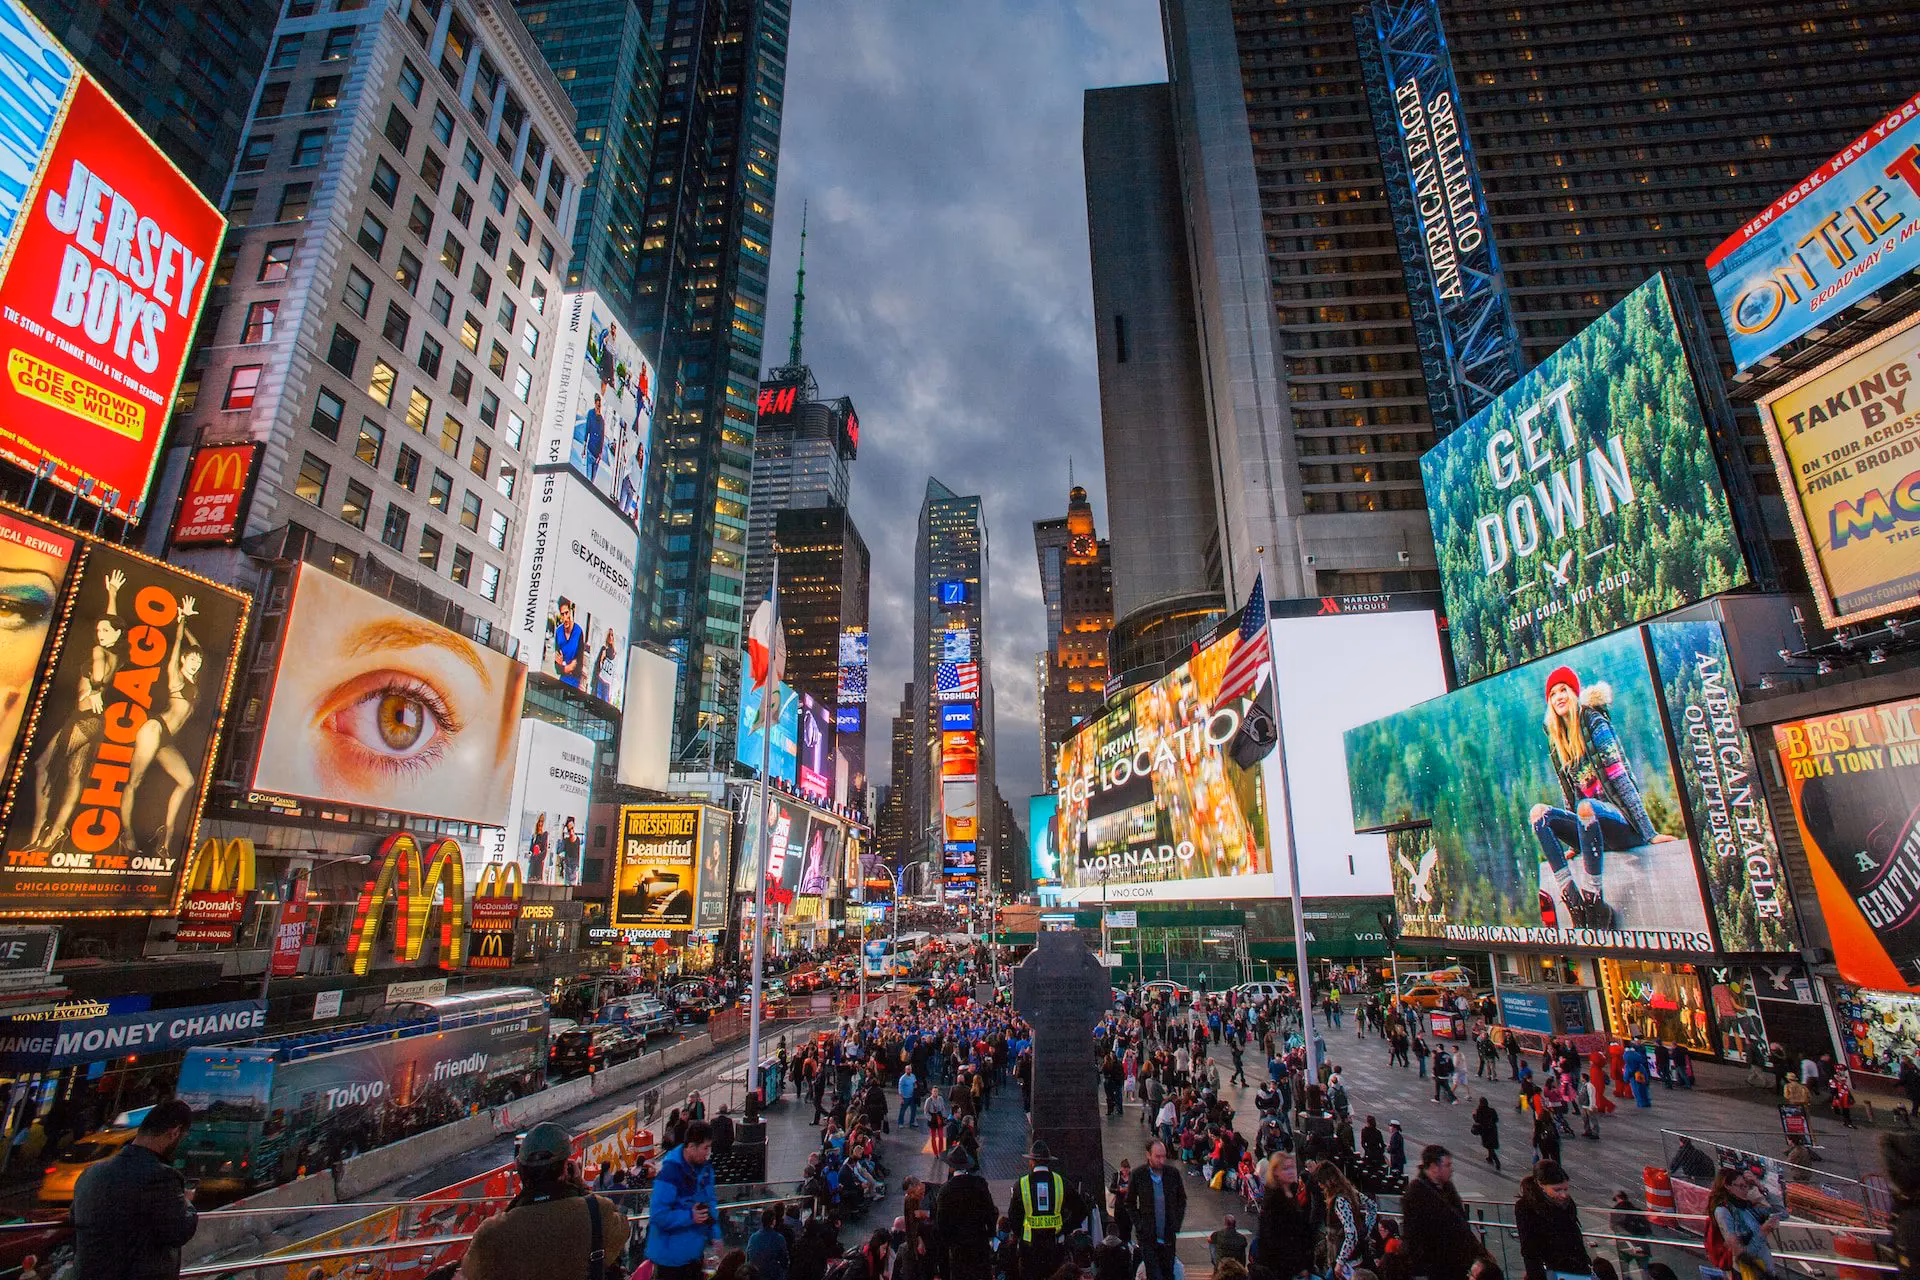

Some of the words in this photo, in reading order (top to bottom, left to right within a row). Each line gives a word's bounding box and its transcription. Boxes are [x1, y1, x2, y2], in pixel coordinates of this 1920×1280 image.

[1395, 76, 1431, 162] EAGLE
[1427, 91, 1483, 254] OUTFITTERS
[1743, 208, 1773, 238] NEW
[1776, 174, 1827, 211] YORK,
[1831, 136, 1869, 172] NEW
[47, 159, 205, 318] JERSEY
[1412, 163, 1464, 301] AMERICAN
[1731, 252, 1820, 335] ON
[1796, 184, 1906, 270] THE
[1809, 238, 1896, 313] BROADWAY'S
[51, 243, 166, 374] BOYS
[4, 306, 19, 324] THE
[20, 316, 45, 338] STORY
[45, 332, 56, 344] OF
[56, 336, 86, 361] FRANKIE
[85, 353, 104, 372] VALLI
[18, 371, 77, 405] GOES
[71, 380, 138, 417] CROWD
[1787, 361, 1913, 436] TAKING
[1860, 387, 1907, 430] BY
[1485, 378, 1578, 490] GET
[1801, 458, 1821, 475] ON
[1822, 440, 1861, 465] TOUR
[1807, 466, 1854, 495] FINAL
[192, 493, 235, 507] OPEN
[193, 506, 227, 525] 24
[1475, 433, 1636, 576] DOWN
[180, 521, 232, 538] HOURS
[24, 534, 63, 558] REVIVAL
[523, 512, 549, 634] @EXPRESSRUNWAY
[949, 585, 958, 600] 7
[1343, 595, 1391, 604] MARRIOTT
[1344, 602, 1386, 611] MARQUIS
[1509, 612, 1533, 632] STAY
[1535, 599, 1568, 621] COOL.
[1570, 585, 1594, 606] NOT
[938, 692, 978, 700] TOSHIBA
[71, 586, 178, 852] CHICAGO
[951, 713, 971, 721] TDK
[1101, 725, 1144, 762] PRIME
[1784, 713, 1872, 760] BEST
[1791, 755, 1835, 780] 2014
[1835, 749, 1885, 774] TONY
[1685, 705, 1737, 857] OUTFITTERS
[1695, 650, 1755, 809] AMERICAN
[1735, 816, 1783, 918] EAGLE
[8, 851, 50, 867] THE
[51, 852, 94, 868] ONE
[95, 855, 129, 869] THE
[131, 856, 177, 871] ONLY
[627, 840, 693, 857] Beautiful
[1082, 840, 1195, 873] VORNADO
[1854, 850, 1881, 873] A
[1136, 865, 1174, 876] TRUST
[474, 903, 518, 912] McDonald's
[1111, 888, 1154, 898] VNO.COM
[177, 930, 197, 938] OPEN
[277, 921, 307, 936] JERSEY
[280, 936, 301, 951] BOYS
[589, 929, 618, 938] GIFTS
[624, 929, 671, 939] LUGGAGE
[1446, 925, 1521, 943] AMERICAN
[1526, 926, 1577, 947] EAGLE
[1581, 928, 1714, 953] OUTFITTERS
[53, 1003, 110, 1020] EXCHANGE
[54, 1021, 164, 1056] MONEY
[169, 1009, 268, 1039] CHANGE
[491, 1024, 521, 1036] UNITED
[433, 1052, 488, 1082] friendly
[327, 1080, 385, 1112] Tokyo
